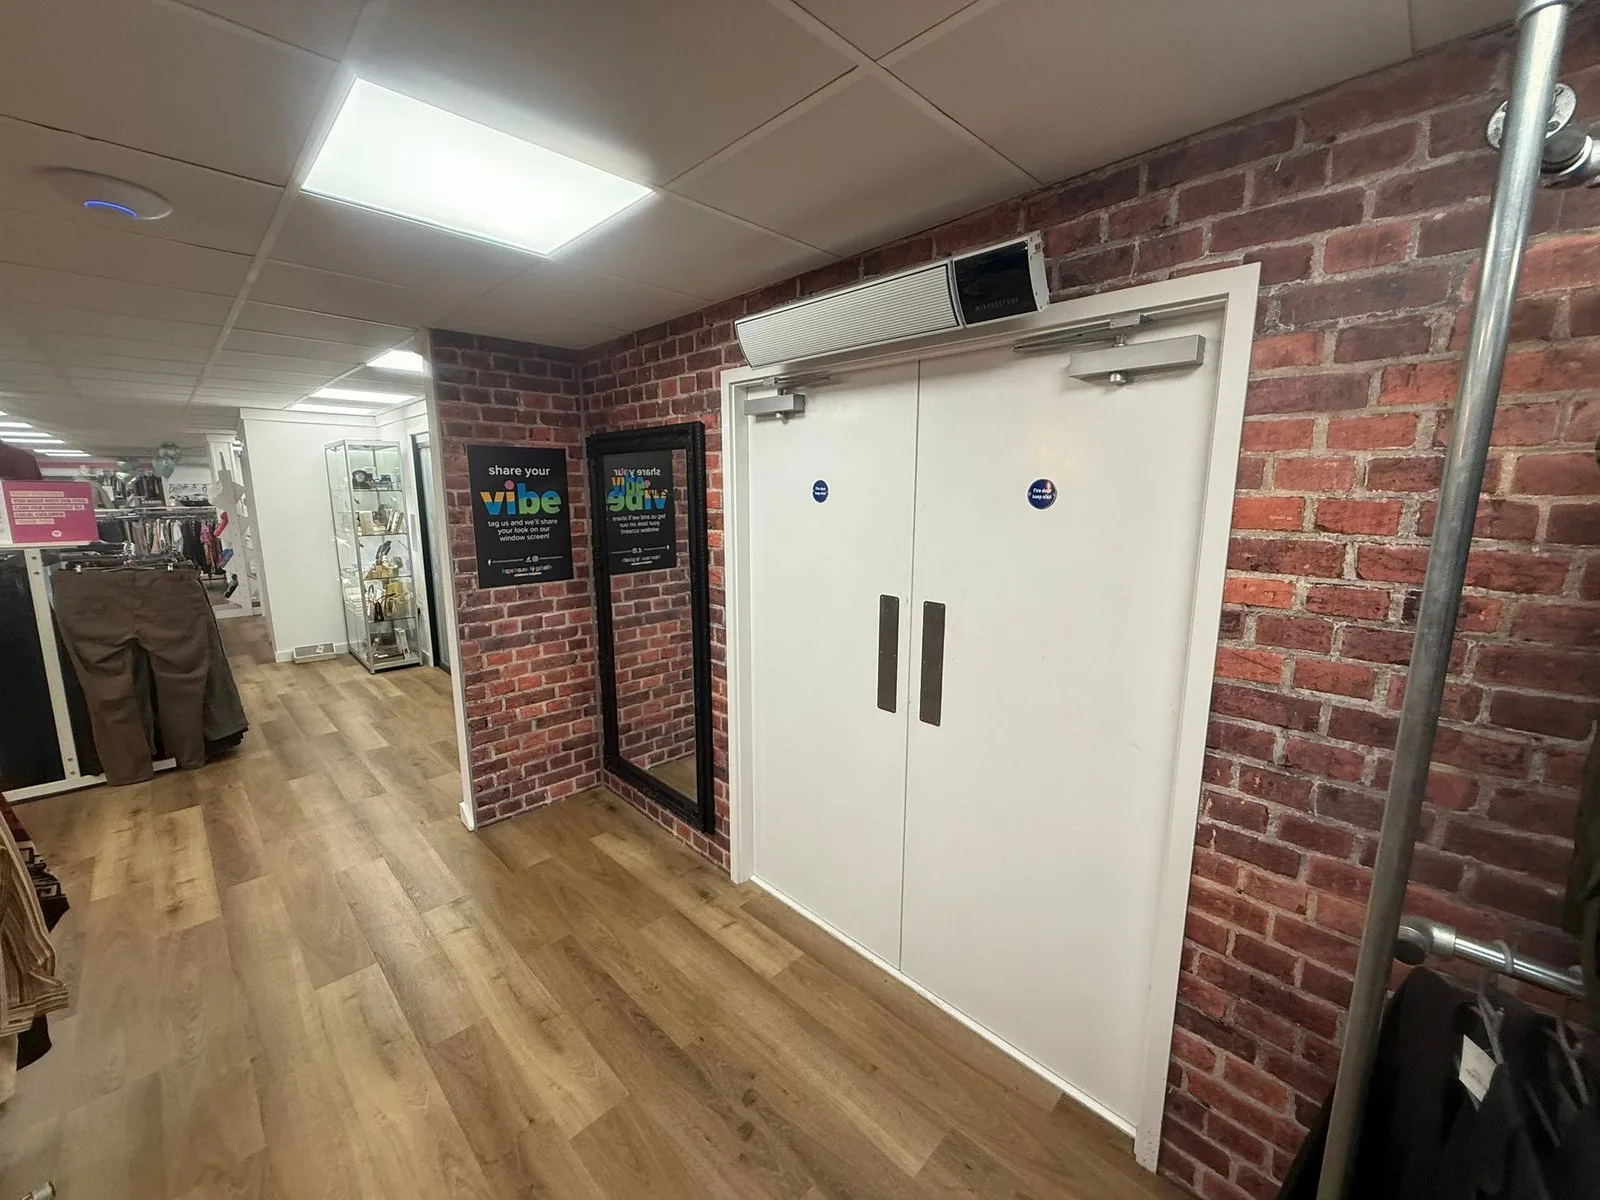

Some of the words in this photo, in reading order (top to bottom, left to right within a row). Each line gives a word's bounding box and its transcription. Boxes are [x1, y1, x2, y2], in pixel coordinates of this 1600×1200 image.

[488, 465, 522, 476] share
[525, 467, 550, 478] your
[480, 480, 562, 515] vibe
